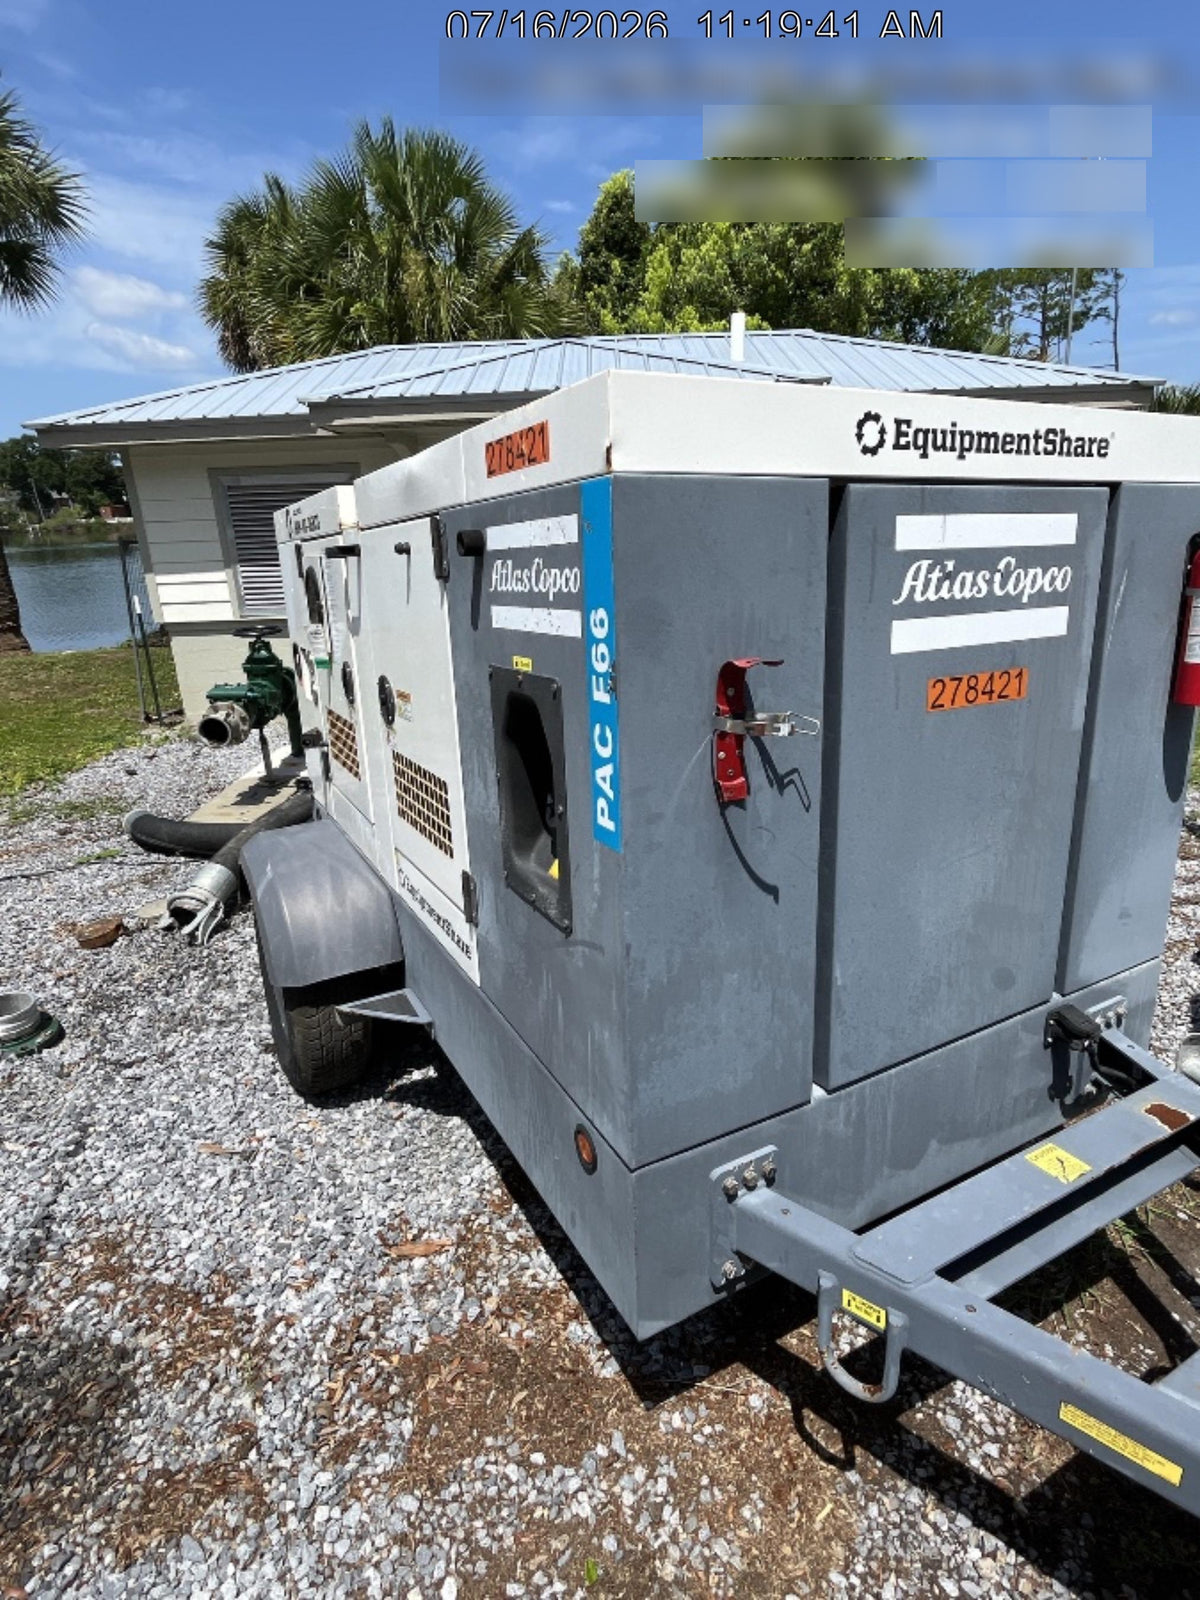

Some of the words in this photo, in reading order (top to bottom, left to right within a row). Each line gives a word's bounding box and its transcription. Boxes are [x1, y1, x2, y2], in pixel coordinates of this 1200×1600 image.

[486, 421, 547, 476] 278421
[892, 417, 1110, 459] EquipmentShare
[489, 559, 531, 593] Atlas
[531, 556, 580, 602] Copco
[993, 556, 1072, 604] Copco
[589, 607, 612, 705] F66
[929, 667, 1024, 710] 278421
[593, 722, 616, 833] PAC
